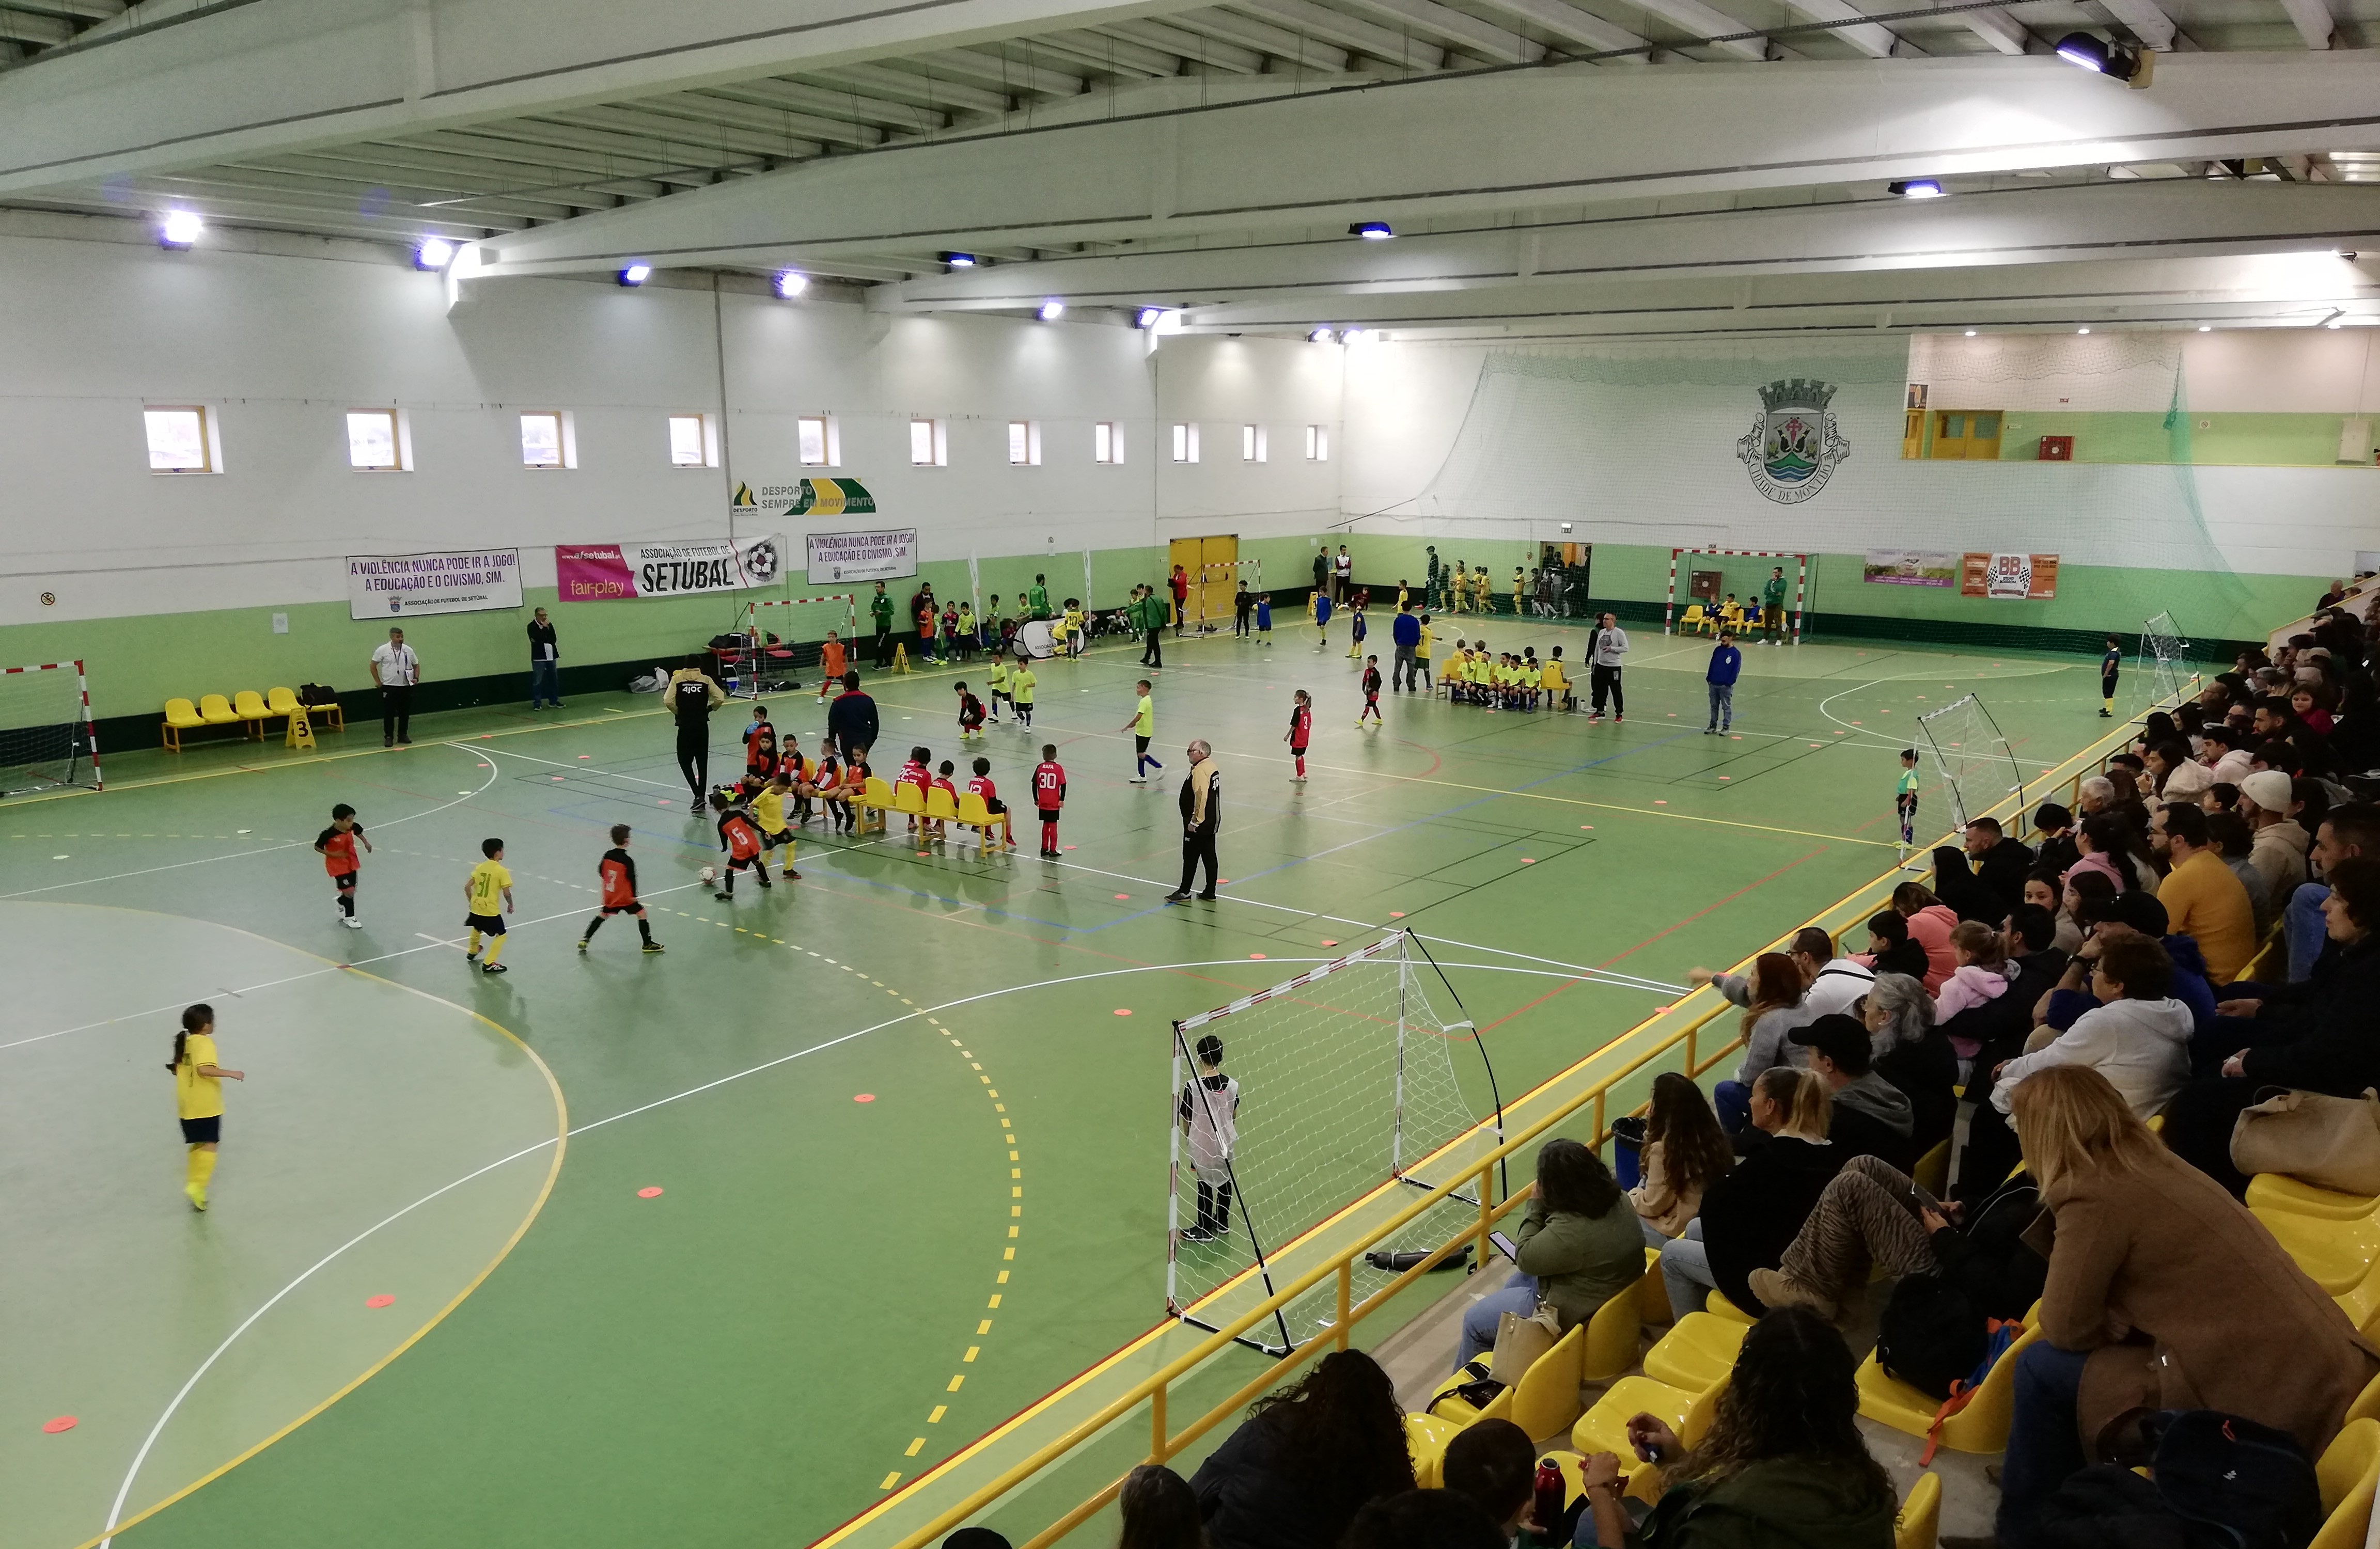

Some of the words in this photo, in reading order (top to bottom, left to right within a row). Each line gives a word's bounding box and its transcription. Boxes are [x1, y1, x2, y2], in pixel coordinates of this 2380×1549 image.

[762, 486, 812, 496] DESPORTO
[1778, 491, 1791, 501] DE
[761, 499, 801, 509] SEMPRE
[804, 498, 817, 508] EM
[820, 497, 874, 507] MOVIMENTO
[809, 539, 814, 549] A
[815, 537, 847, 549] VIOLÊNCIA
[849, 536, 869, 547] NUNCA
[870, 535, 885, 546] PODE
[887, 535, 892, 545] IR
[894, 534, 898, 545] A
[899, 533, 914, 544] JOGO!
[641, 547, 682, 559] ASSOCIAÇÃO
[682, 548, 692, 558] DE
[691, 546, 721, 557] FUTEBOL
[721, 545, 731, 554] DE
[818, 552, 823, 562] A
[824, 549, 855, 562] EDUCAÇÃO
[857, 550, 861, 560] E
[862, 550, 866, 560] O
[868, 547, 895, 559] CIVISMO,
[895, 546, 907, 557] SIM.
[351, 562, 358, 575] A
[361, 559, 411, 574] VIOLÊNCIA
[412, 558, 445, 572] NUNCA
[446, 557, 471, 570] PODE
[472, 557, 481, 568] IR
[484, 556, 490, 567] A
[492, 554, 515, 567] JOGO!
[1999, 556, 2021, 575] BB
[366, 579, 372, 591] A
[374, 575, 425, 591] EDUCAÇÃO
[428, 576, 433, 588] E
[435, 575, 441, 587] O
[444, 572, 483, 587] CIVISMO,
[486, 571, 505, 583] SIM.
[641, 558, 734, 592] SETÚBAL
[570, 578, 623, 597] fair-play
[1068, 615, 1078, 626] 10
[296, 720, 309, 737] 3
[1039, 772, 1057, 789] 30
[731, 826, 748, 845] 6
[477, 873, 491, 898] 31
